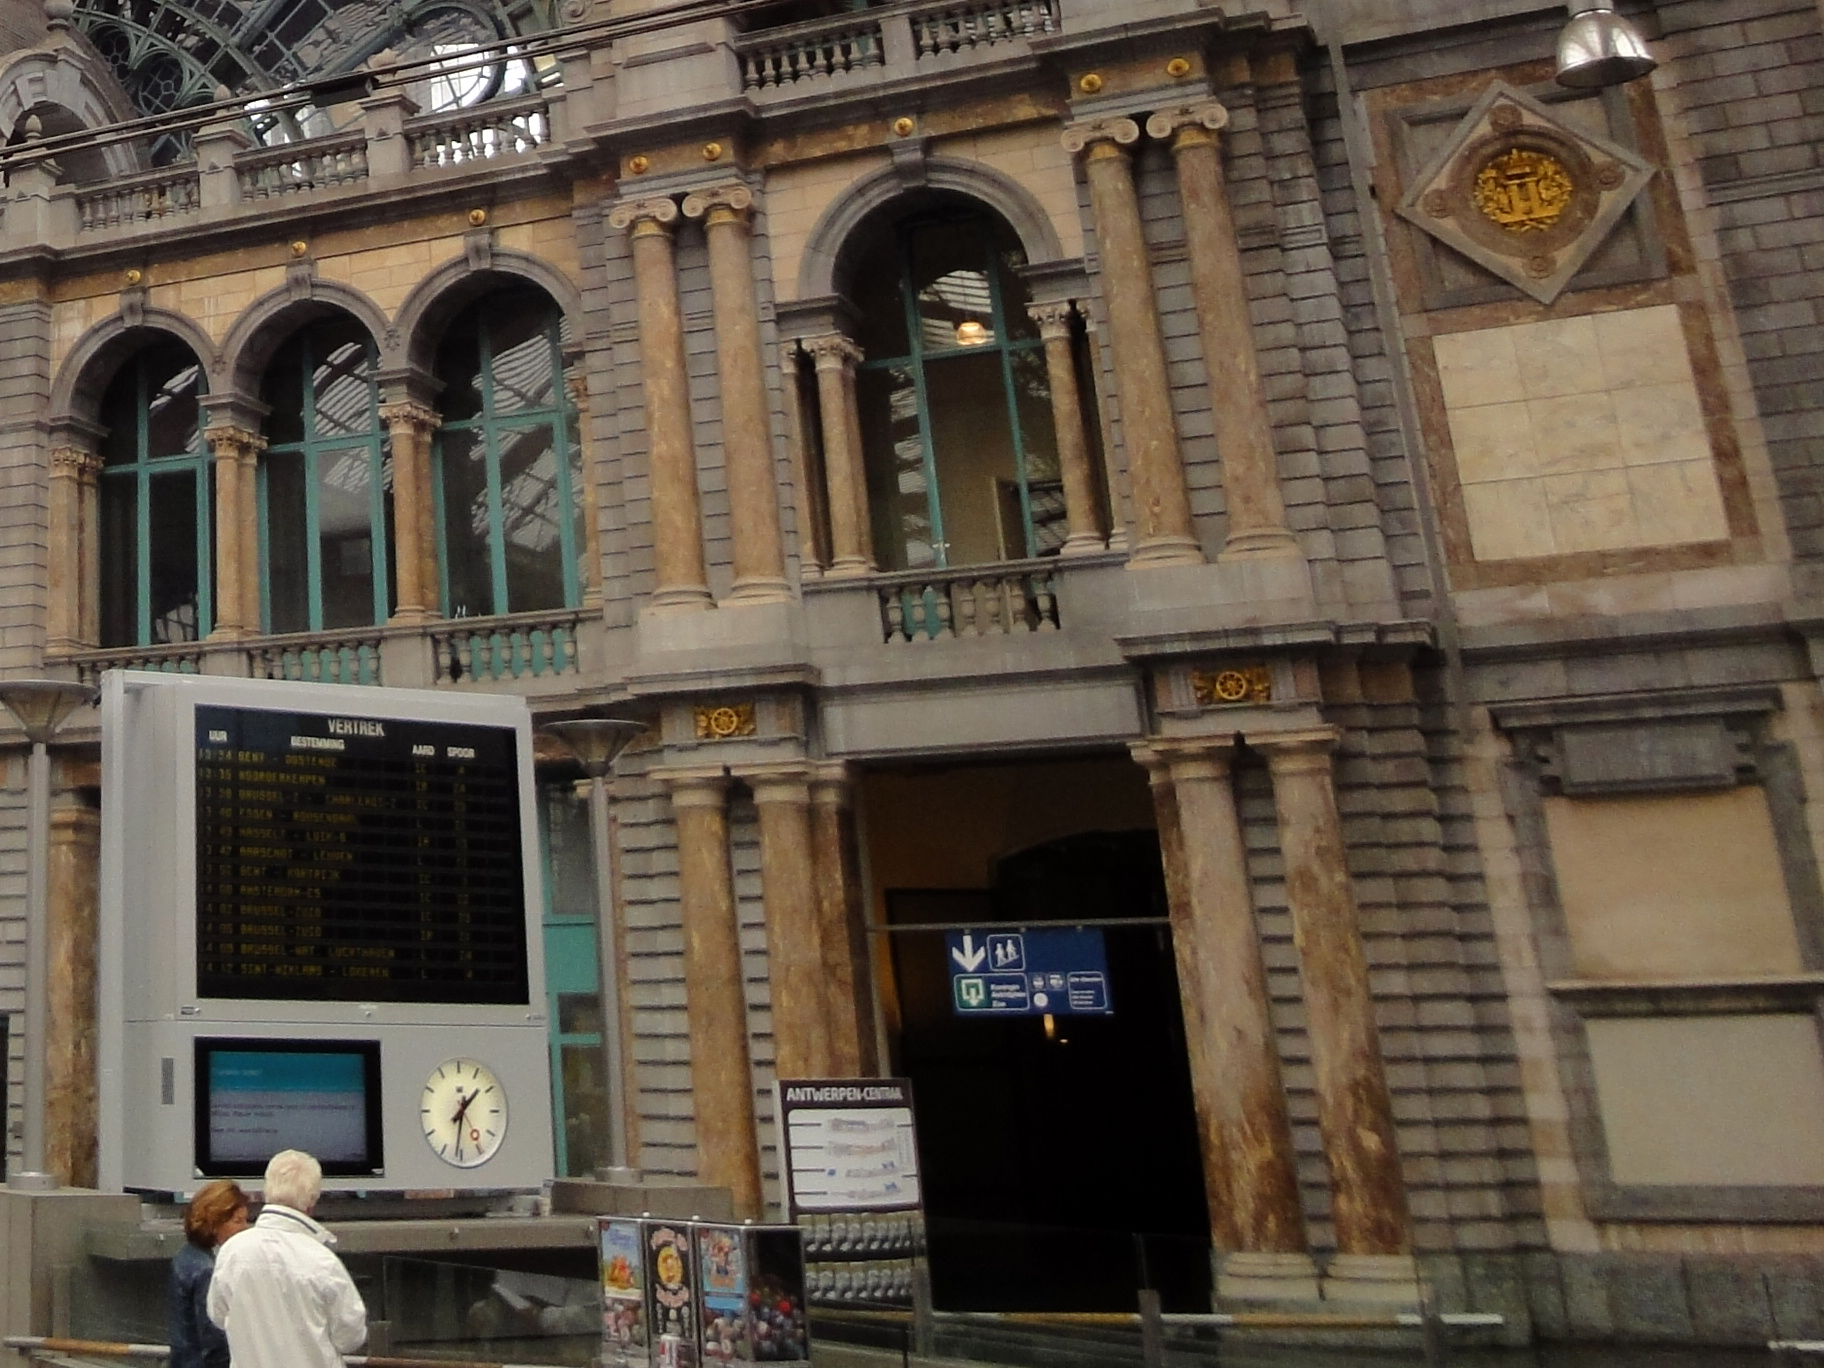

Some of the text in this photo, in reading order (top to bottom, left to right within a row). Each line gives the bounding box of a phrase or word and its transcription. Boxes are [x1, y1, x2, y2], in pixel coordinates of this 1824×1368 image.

[328, 719, 385, 737] VERTREK
[208, 730, 475, 759] UUR BESTEMMING AARD SPOOR
